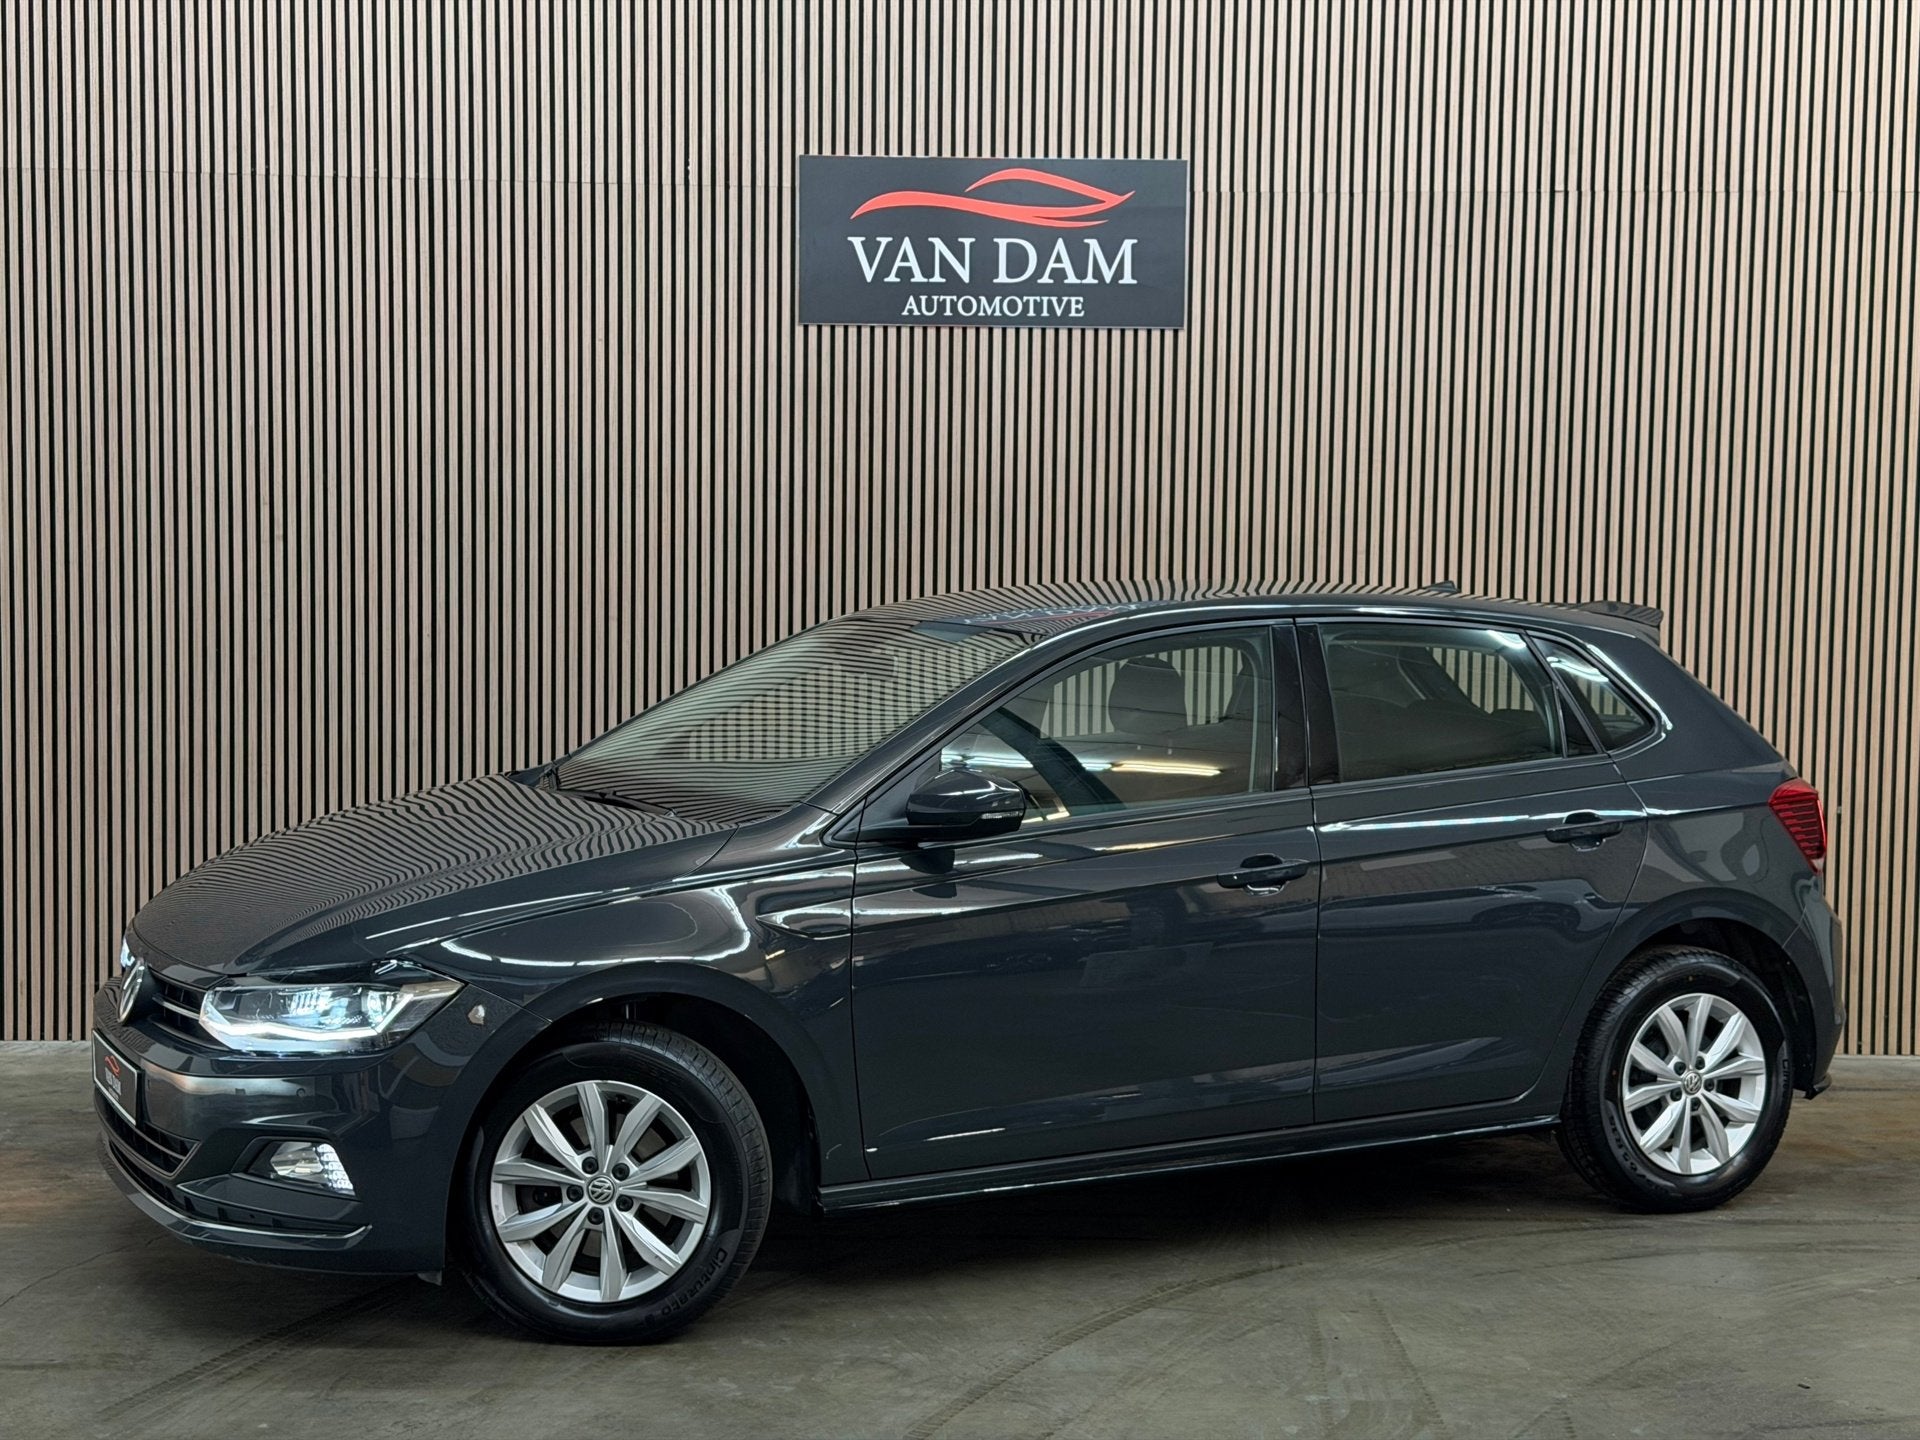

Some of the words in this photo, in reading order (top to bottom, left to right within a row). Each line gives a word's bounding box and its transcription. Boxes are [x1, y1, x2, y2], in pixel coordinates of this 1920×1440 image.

[847, 236, 976, 283] VAN
[993, 237, 1138, 285] DAM
[901, 294, 1085, 317] AUTOMOTIVE
